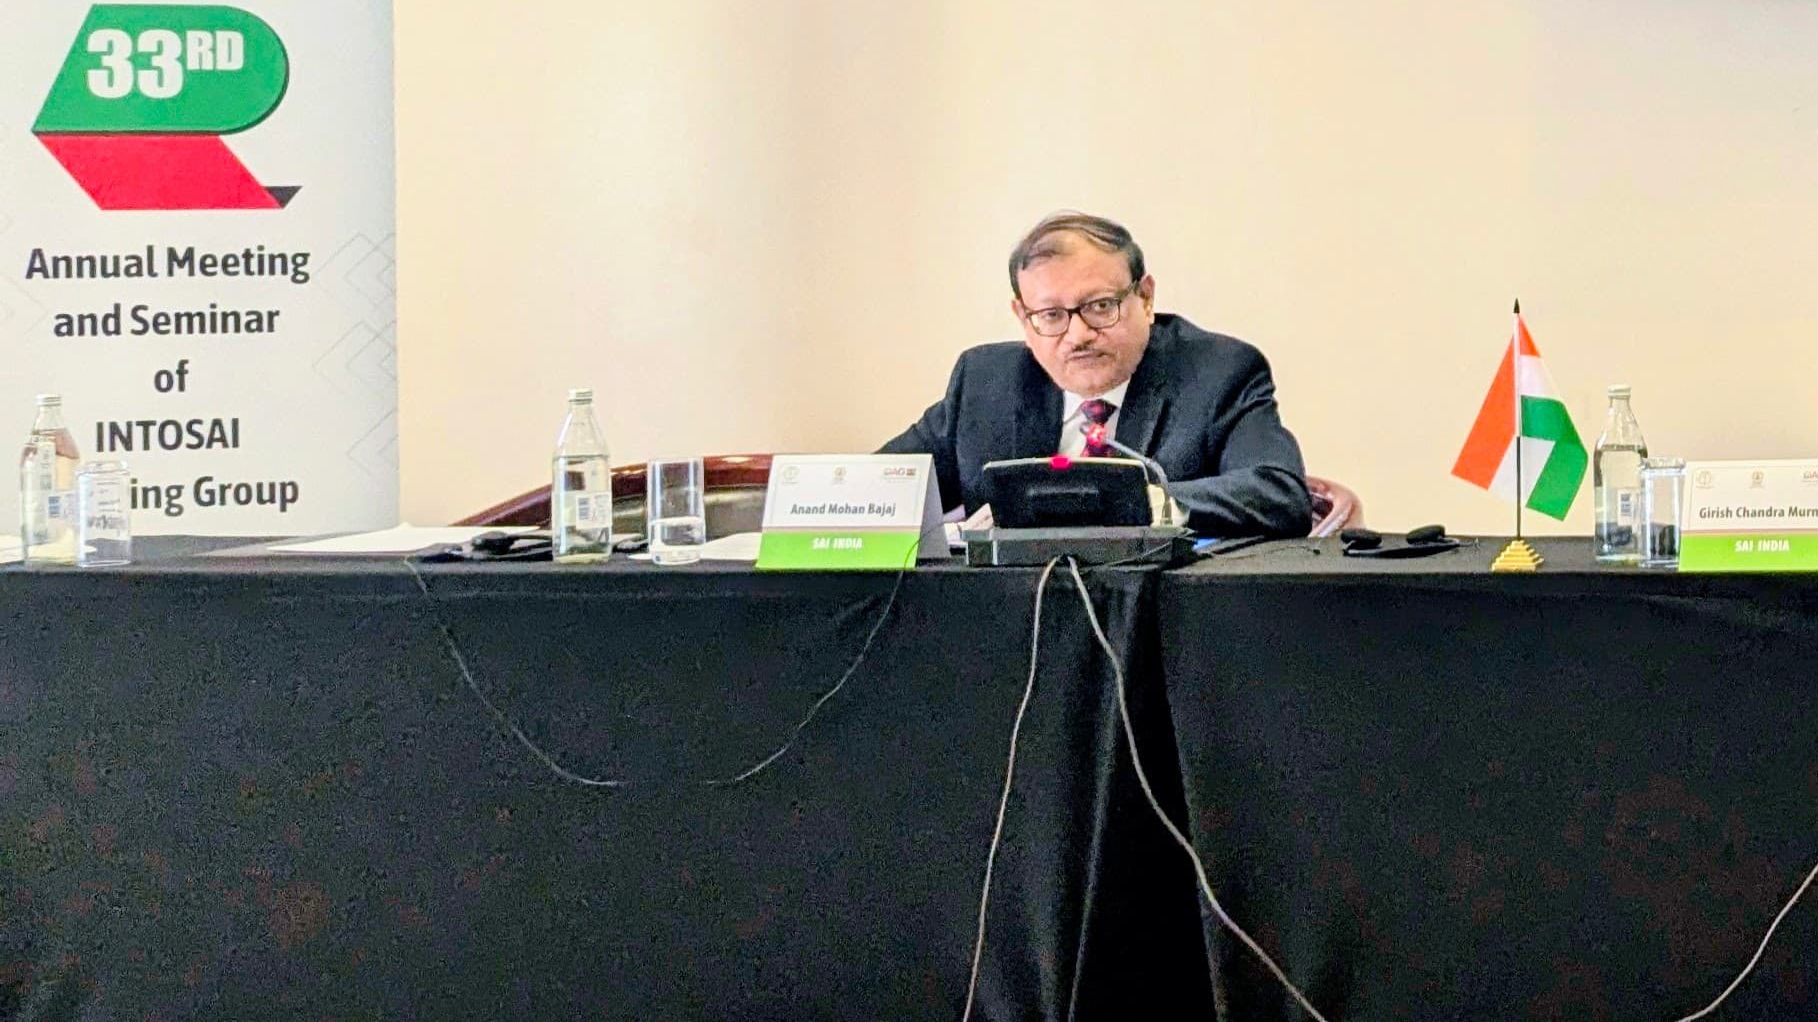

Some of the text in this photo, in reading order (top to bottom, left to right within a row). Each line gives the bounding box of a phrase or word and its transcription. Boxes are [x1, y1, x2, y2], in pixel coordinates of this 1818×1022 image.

[86, 28, 245, 99] 33RD
[26, 245, 311, 285] Annual Meeting
[53, 303, 281, 337] and Seminar
[153, 359, 190, 393] of
[95, 418, 240, 453] INTOSAI
[192, 476, 300, 513] Group
[790, 502, 896, 518] Anand Mohan Bajaj
[1699, 506, 1733, 519] Girish
[1736, 505, 1785, 518] Chandra
[813, 537, 864, 550] SAI INDIA
[1735, 540, 1790, 552] SAI INDIA
